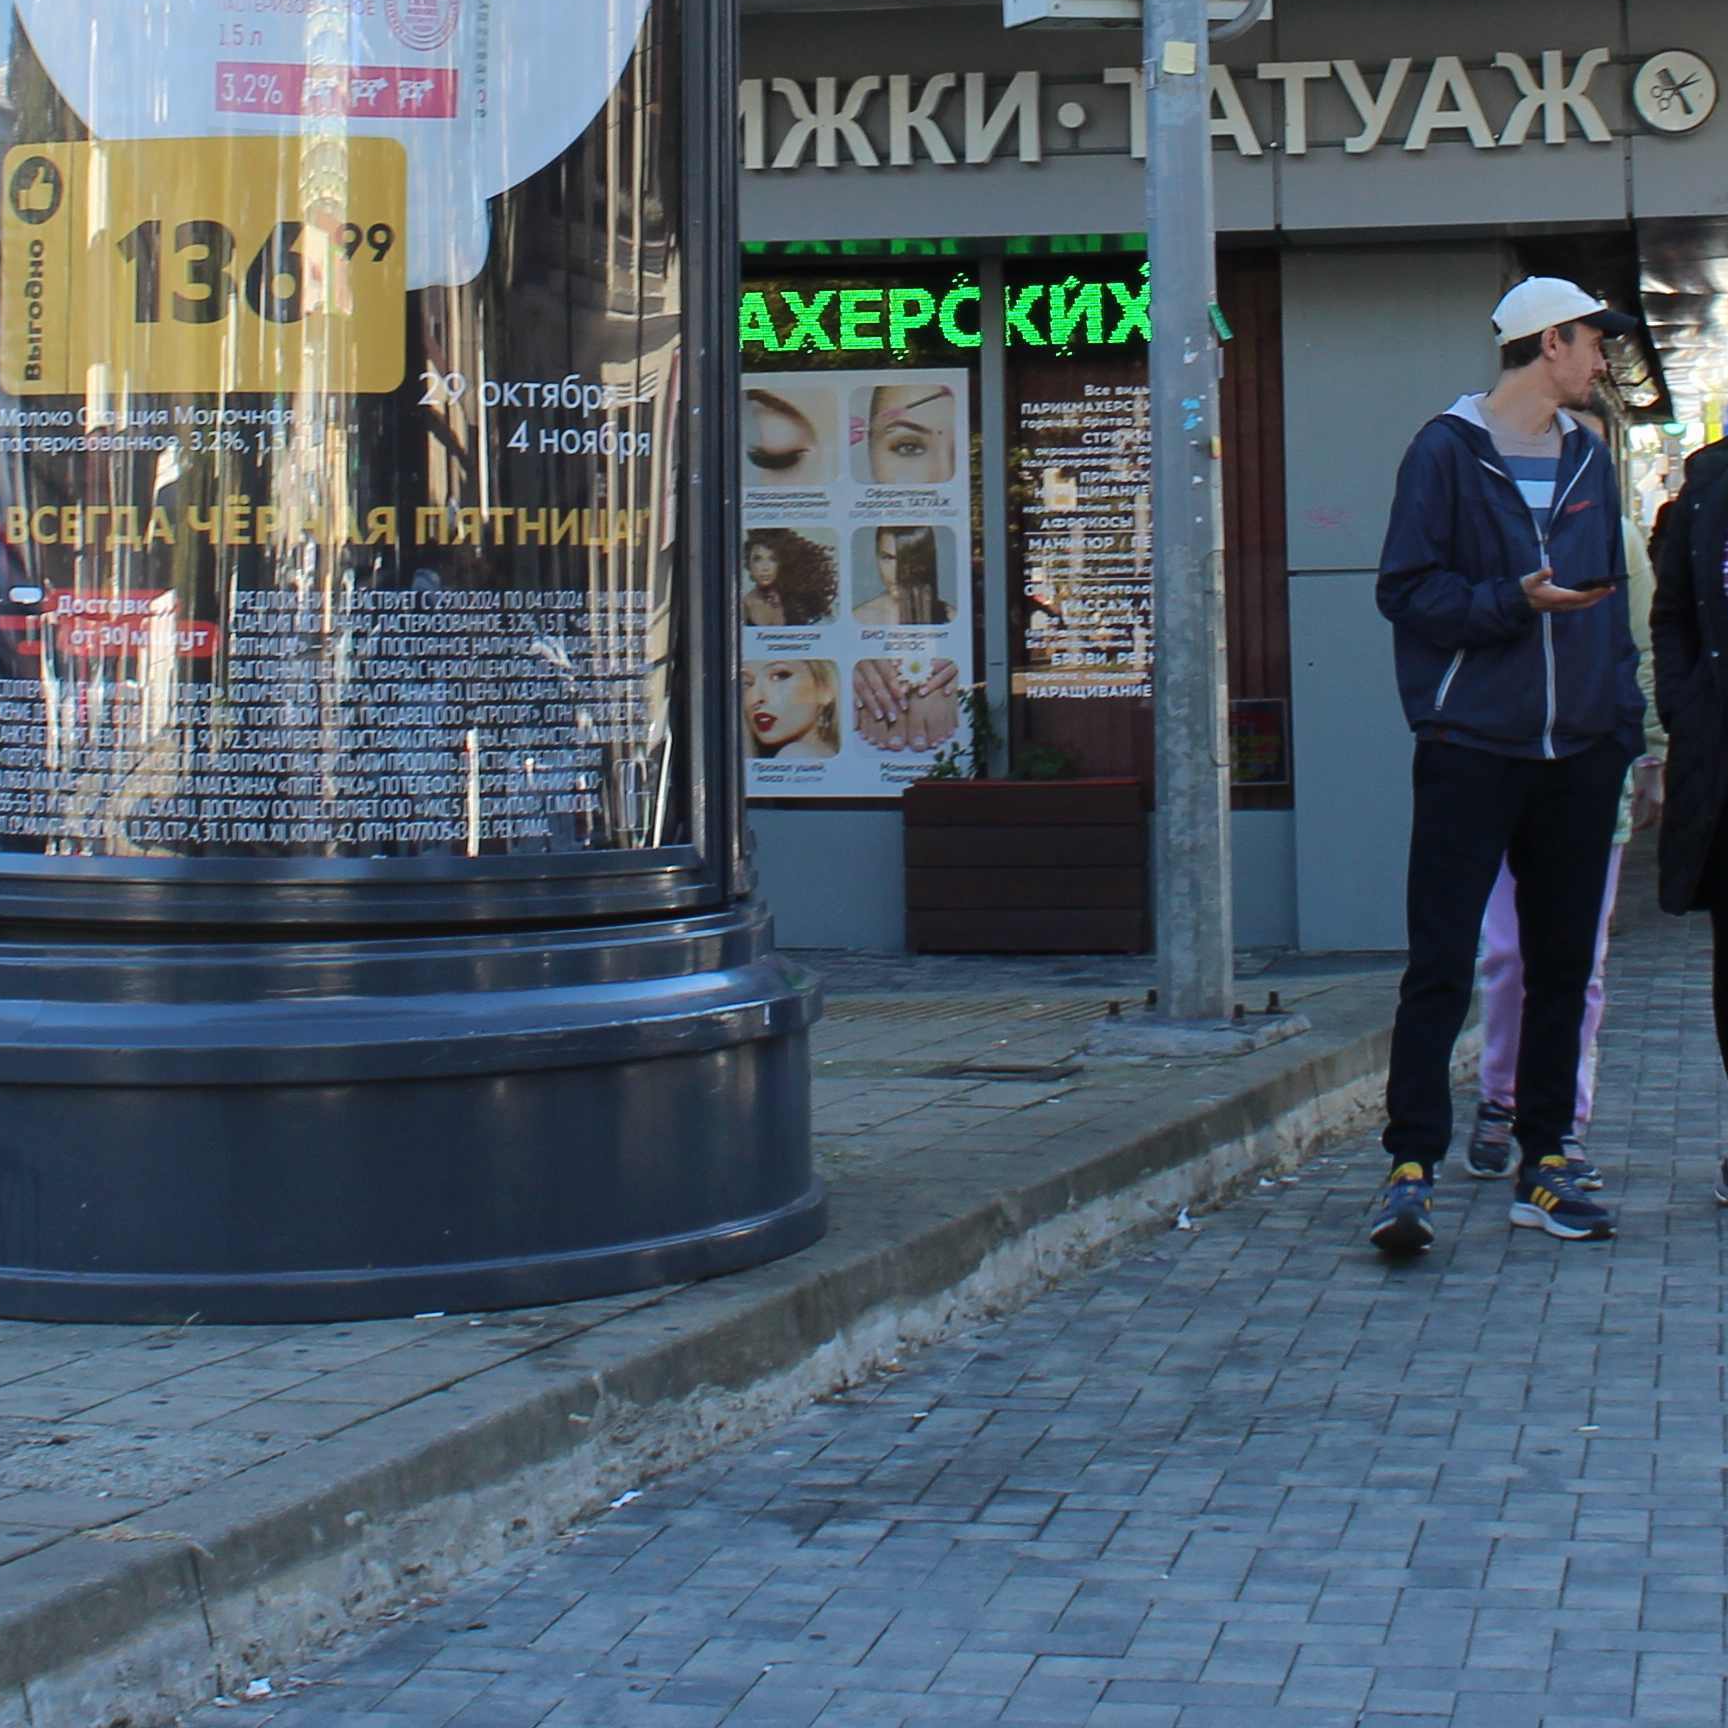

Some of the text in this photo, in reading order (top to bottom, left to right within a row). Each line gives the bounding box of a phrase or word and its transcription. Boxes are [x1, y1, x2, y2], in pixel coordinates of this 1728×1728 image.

[24, 239, 46, 382] Выгодно
[418, 373, 467, 406] 29
[0, 405, 295, 428] Молоко Молочная
[507, 420, 652, 465] 4 ноября
[6, 506, 175, 552] ВСЕГДА
[57, 594, 170, 617] Доставк
[70, 630, 97, 647] от
[99, 627, 126, 648] 30
